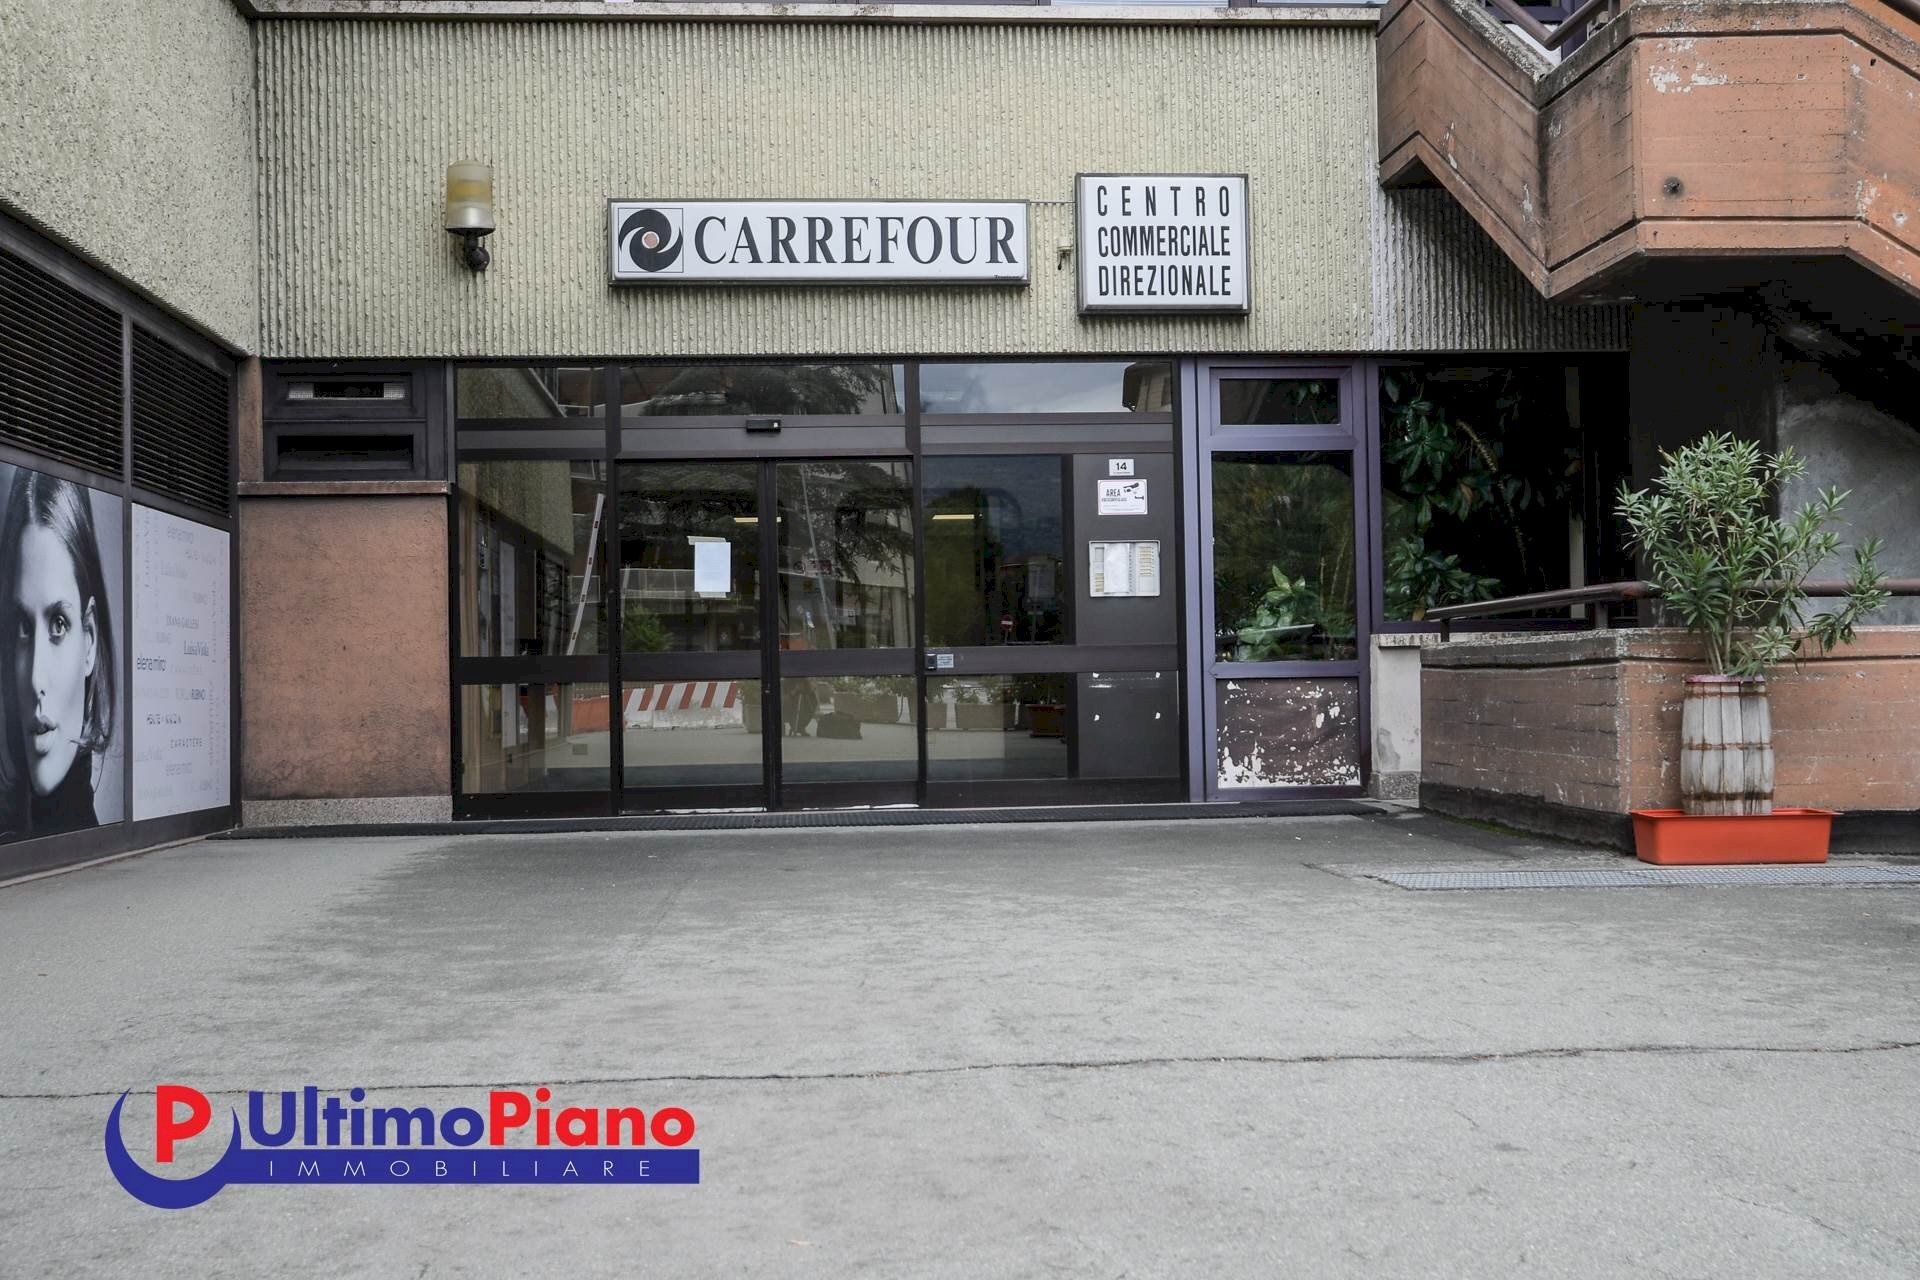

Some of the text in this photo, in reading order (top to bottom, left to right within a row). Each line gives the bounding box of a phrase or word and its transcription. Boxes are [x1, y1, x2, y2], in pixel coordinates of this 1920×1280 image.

[1097, 185, 1230, 216] CENTRO
[694, 214, 1019, 265] CARREFOUR
[1098, 225, 1231, 257] COMMERCIALE
[1099, 264, 1232, 296] DIREZIONALE
[1115, 462, 1127, 471] 14
